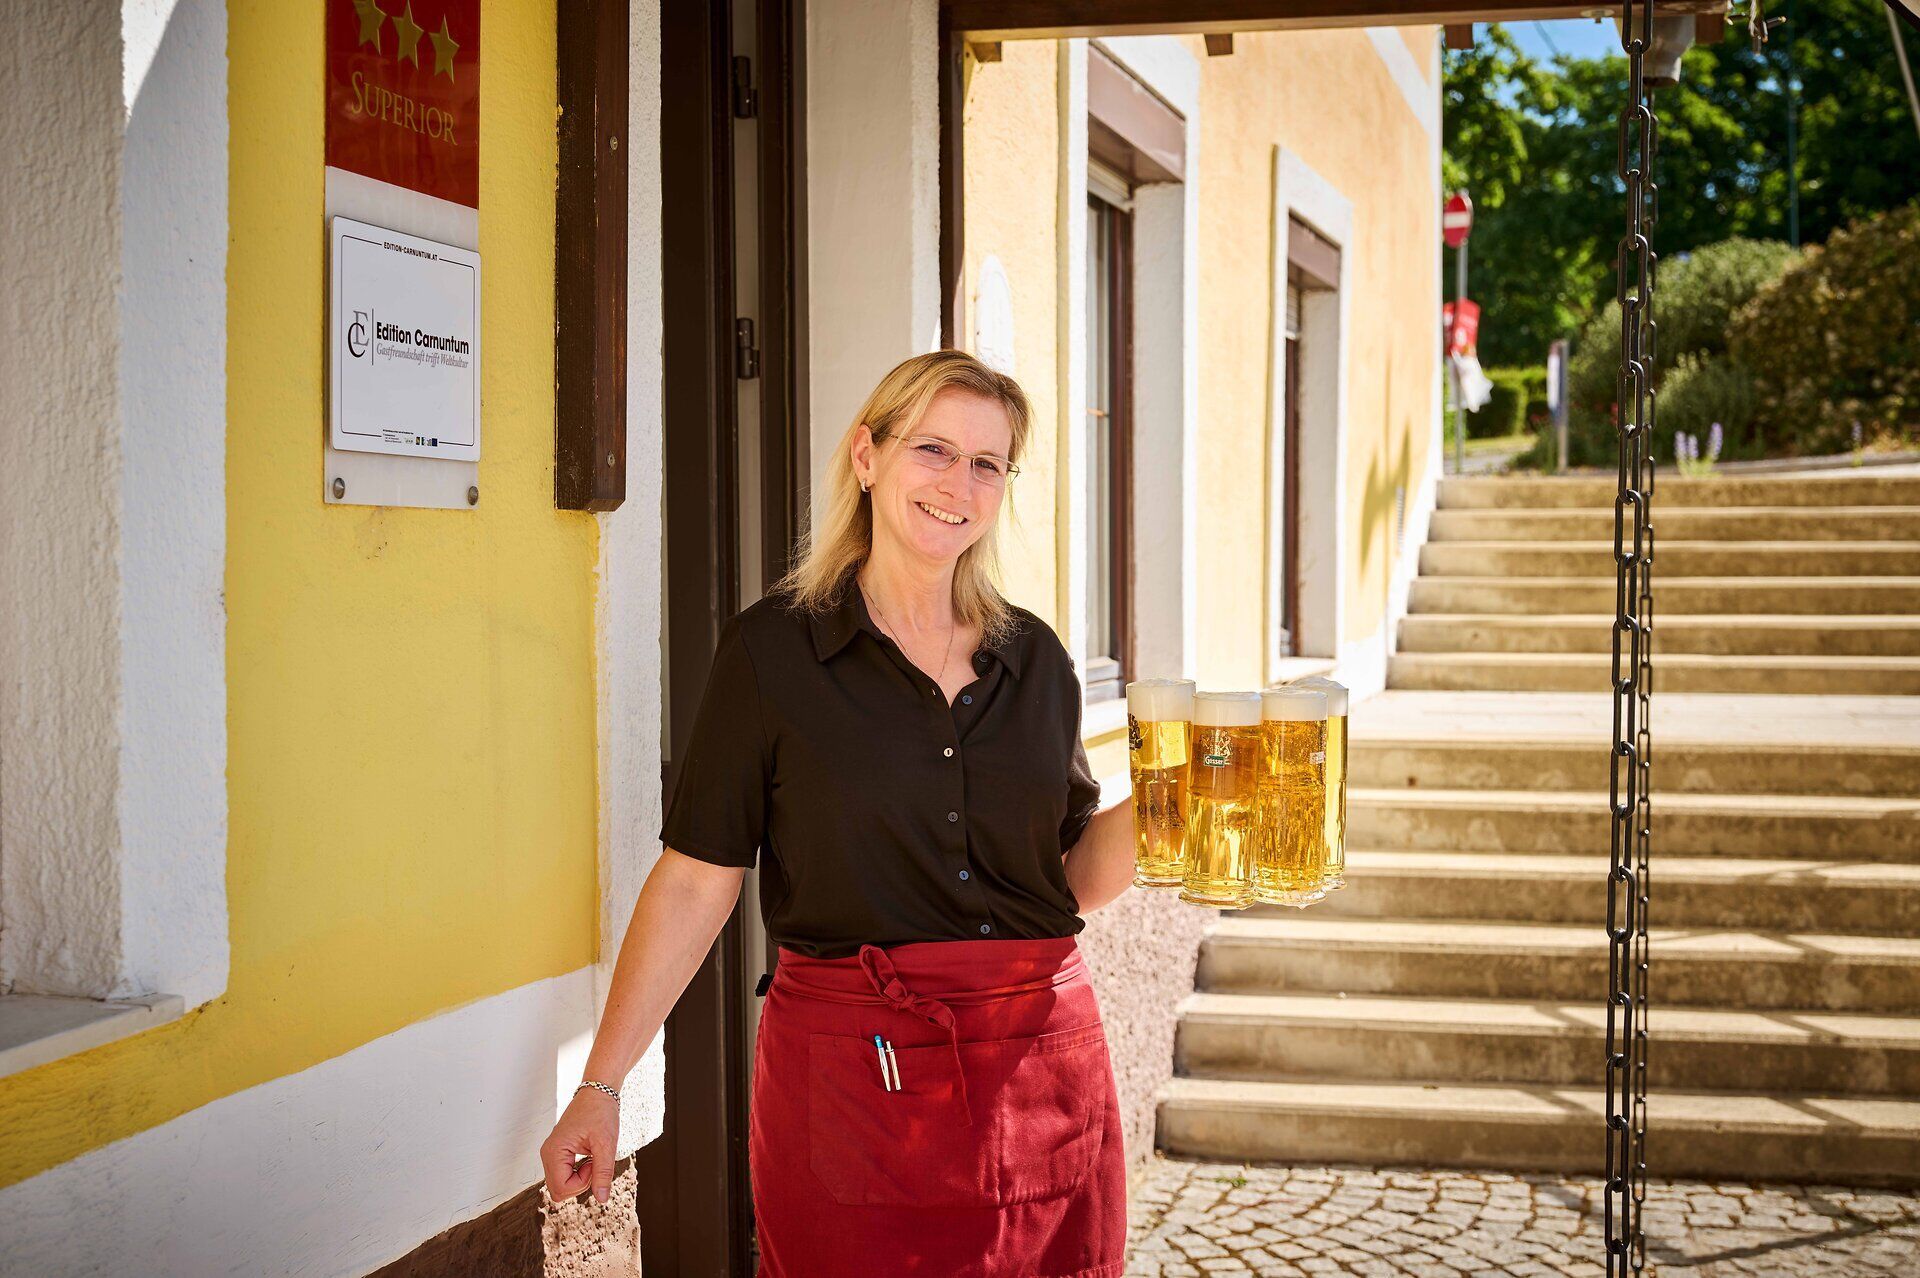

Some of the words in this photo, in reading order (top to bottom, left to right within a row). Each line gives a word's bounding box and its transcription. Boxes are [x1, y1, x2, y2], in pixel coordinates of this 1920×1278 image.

[384, 242, 438, 261] EDITION-CARNUNTUM.AT
[377, 322, 411, 344] Edition
[415, 329, 469, 354] Carnuntum
[377, 343, 425, 365] Gastfreundschaft
[425, 352, 440, 368] trifft
[440, 353, 469, 369] Weltkultur
